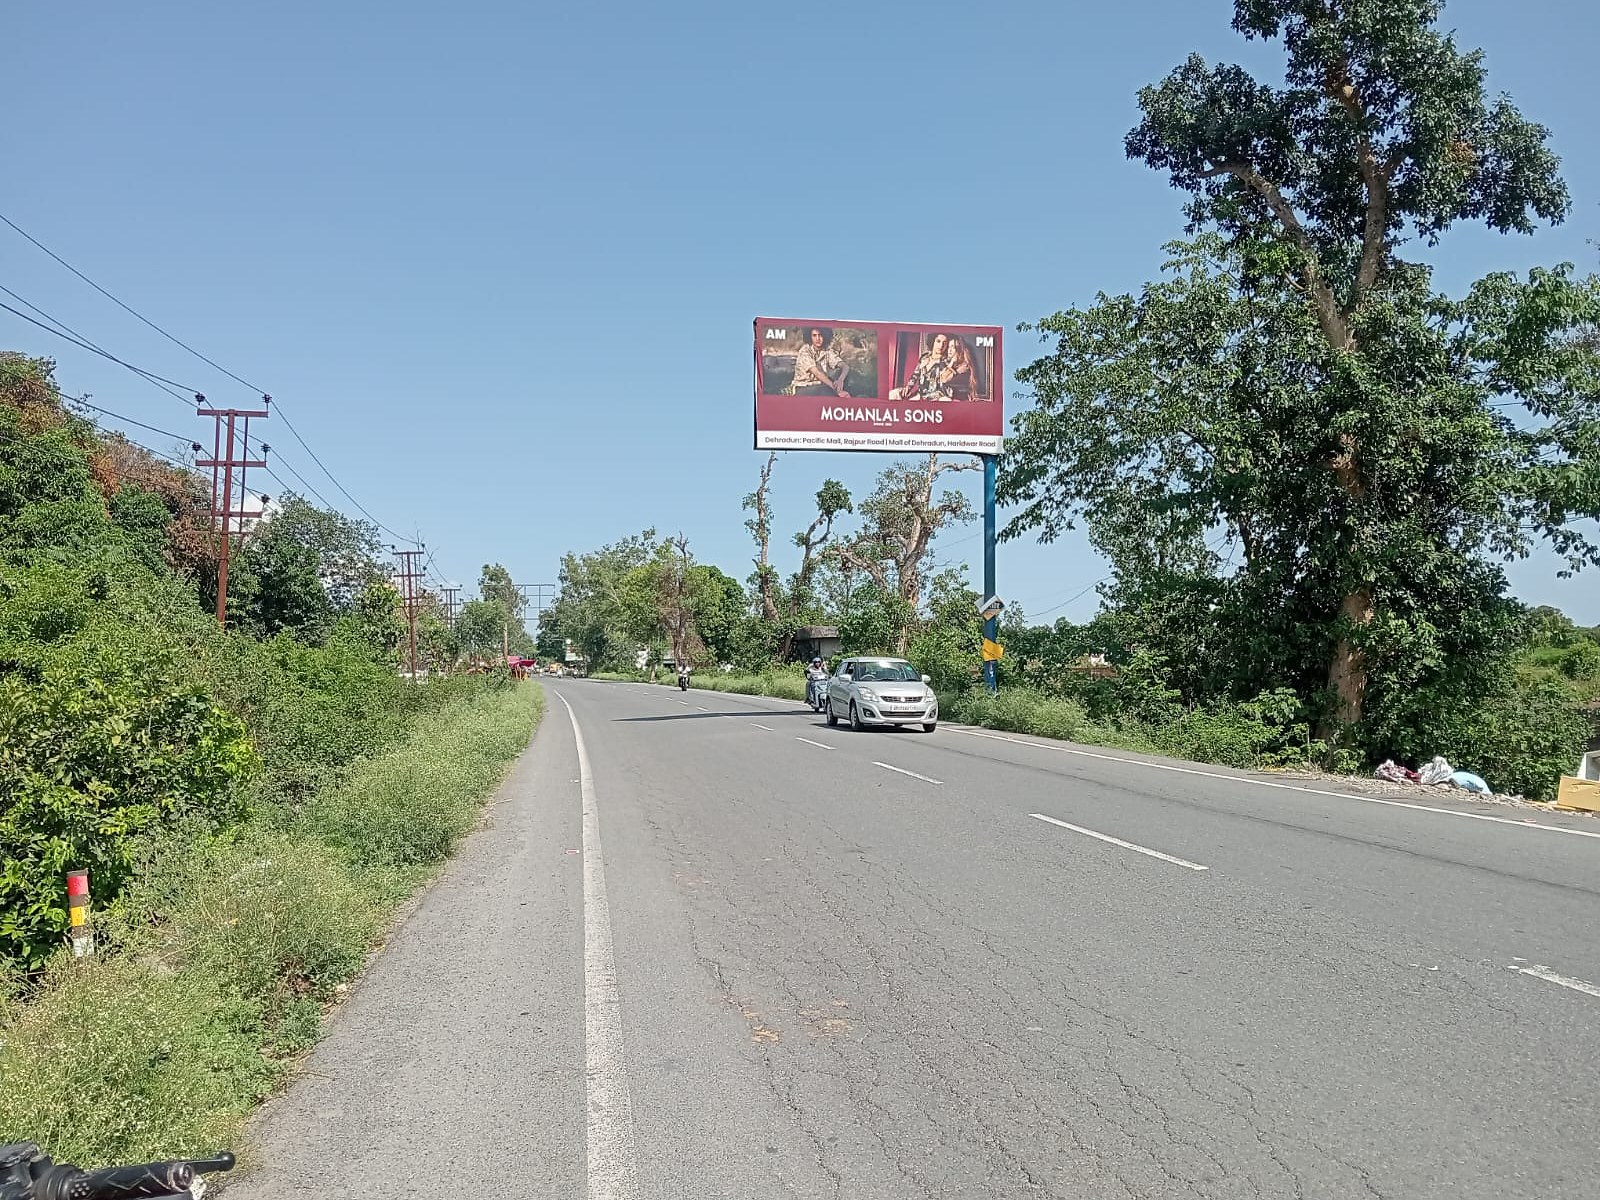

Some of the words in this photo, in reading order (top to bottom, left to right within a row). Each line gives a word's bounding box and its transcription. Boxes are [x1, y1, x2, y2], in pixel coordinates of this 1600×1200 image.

[765, 328, 786, 340] AM
[975, 336, 994, 347] PM
[820, 406, 899, 422] MOHANLAL
[904, 409, 943, 424] SONS
[764, 436, 802, 444] Dehradun:
[826, 437, 843, 446] Mall,
[843, 438, 866, 447] Rajpur
[866, 438, 885, 446] Road
[911, 440, 947, 448] Dehradun,
[978, 440, 996, 448] Road
